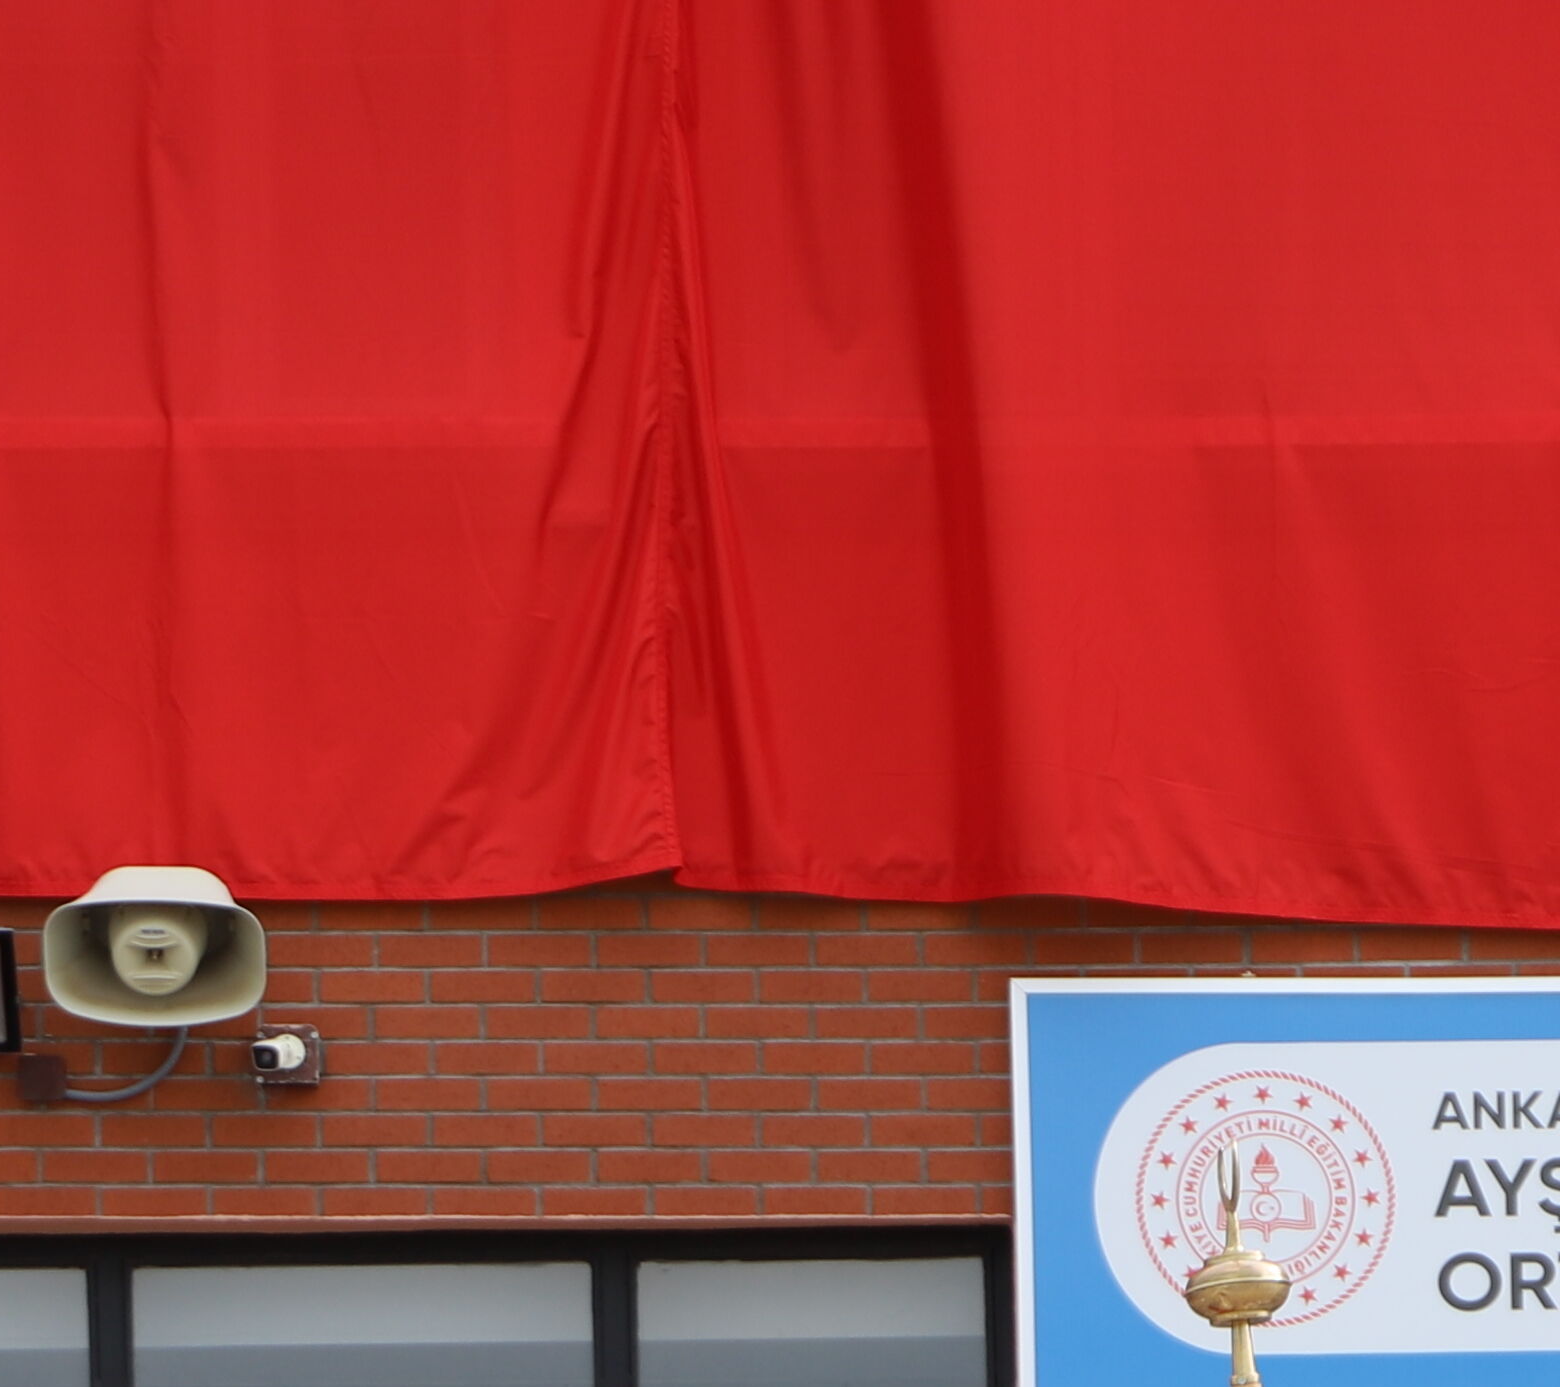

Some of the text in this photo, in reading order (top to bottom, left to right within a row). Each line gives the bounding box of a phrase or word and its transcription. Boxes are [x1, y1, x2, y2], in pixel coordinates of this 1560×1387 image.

[1183, 1115, 1253, 1217] CUMHURİYETİ
[1306, 1134, 1347, 1190] EĞİTİM
[1287, 1196, 1348, 1276] BAKANLIĞI
